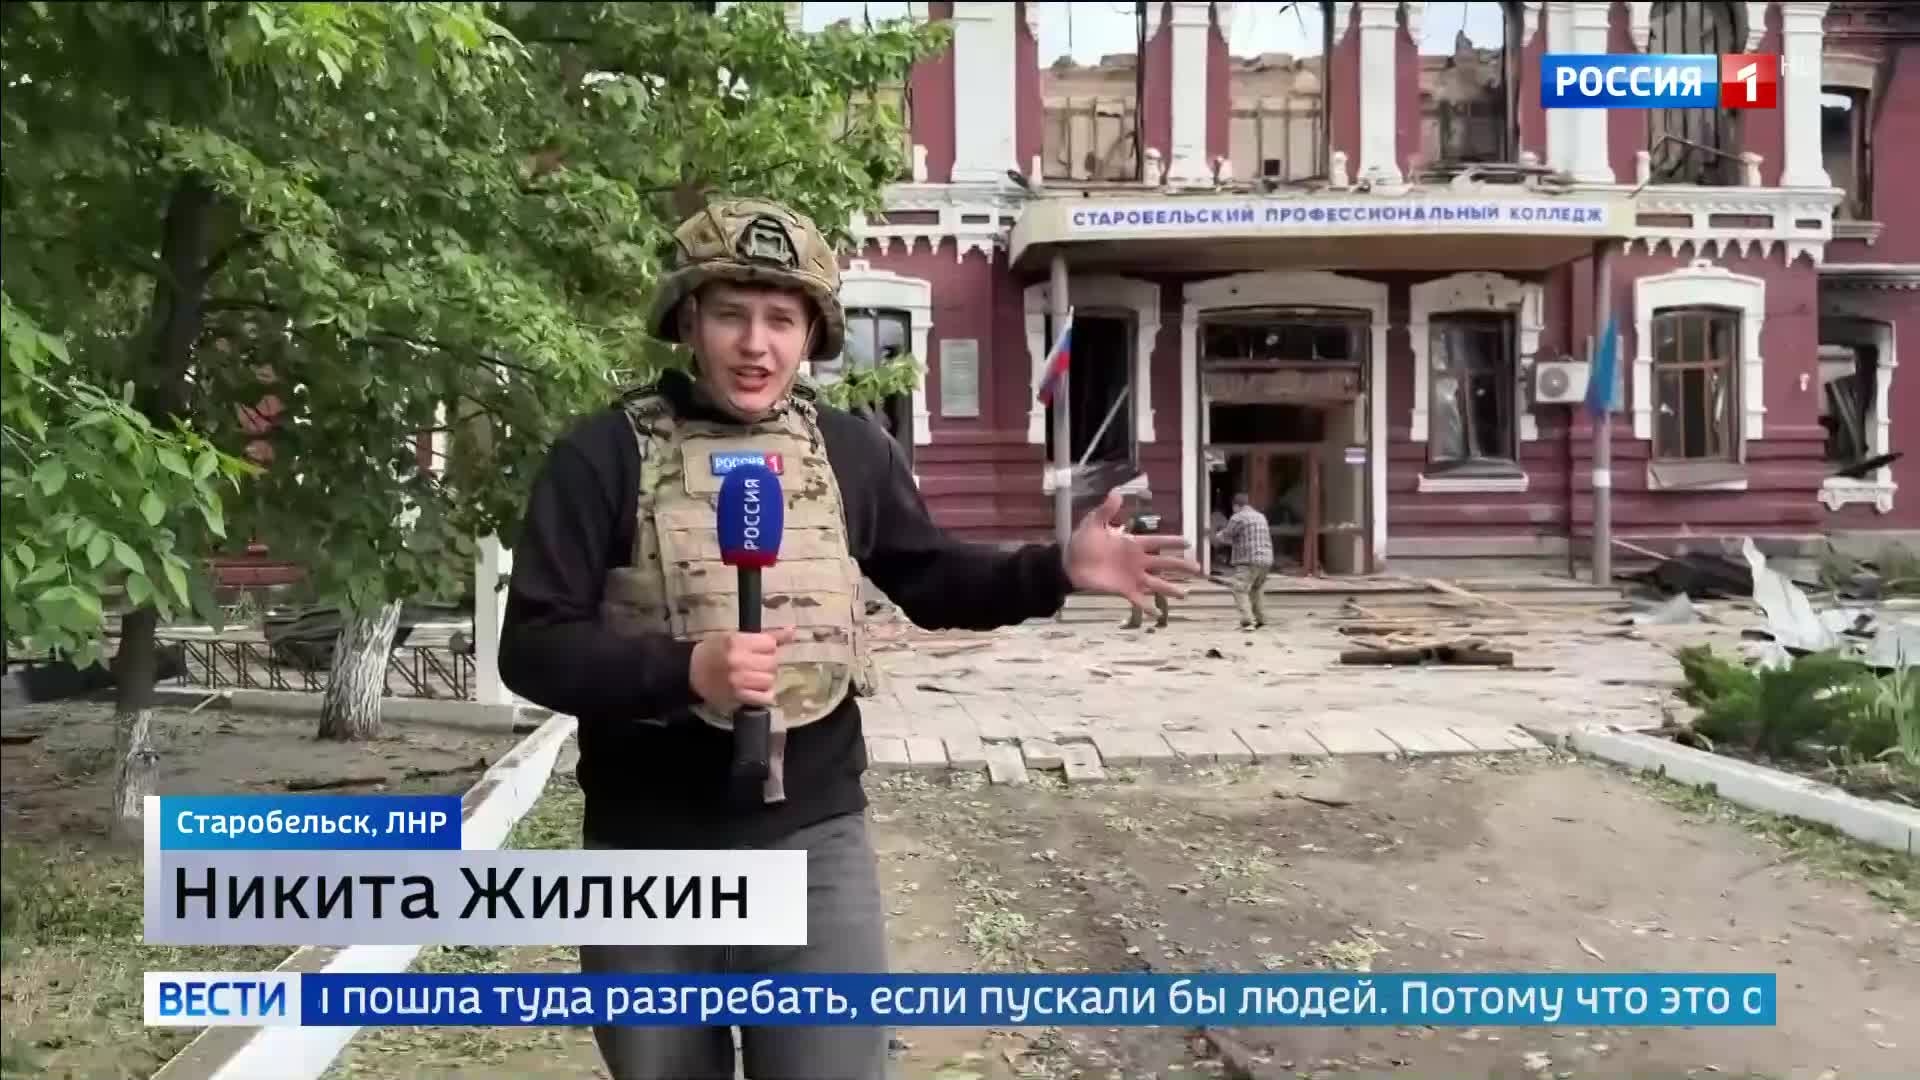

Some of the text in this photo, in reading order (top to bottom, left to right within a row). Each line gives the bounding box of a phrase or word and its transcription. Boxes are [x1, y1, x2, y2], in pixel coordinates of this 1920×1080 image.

[1072, 205, 1603, 227] СТАРОБЕЛЬСКИЙ ПРОФЕССИОНАЛЬНЫЙ КОЛЛЕДЖ
[743, 478, 761, 551] РОССИЯ
